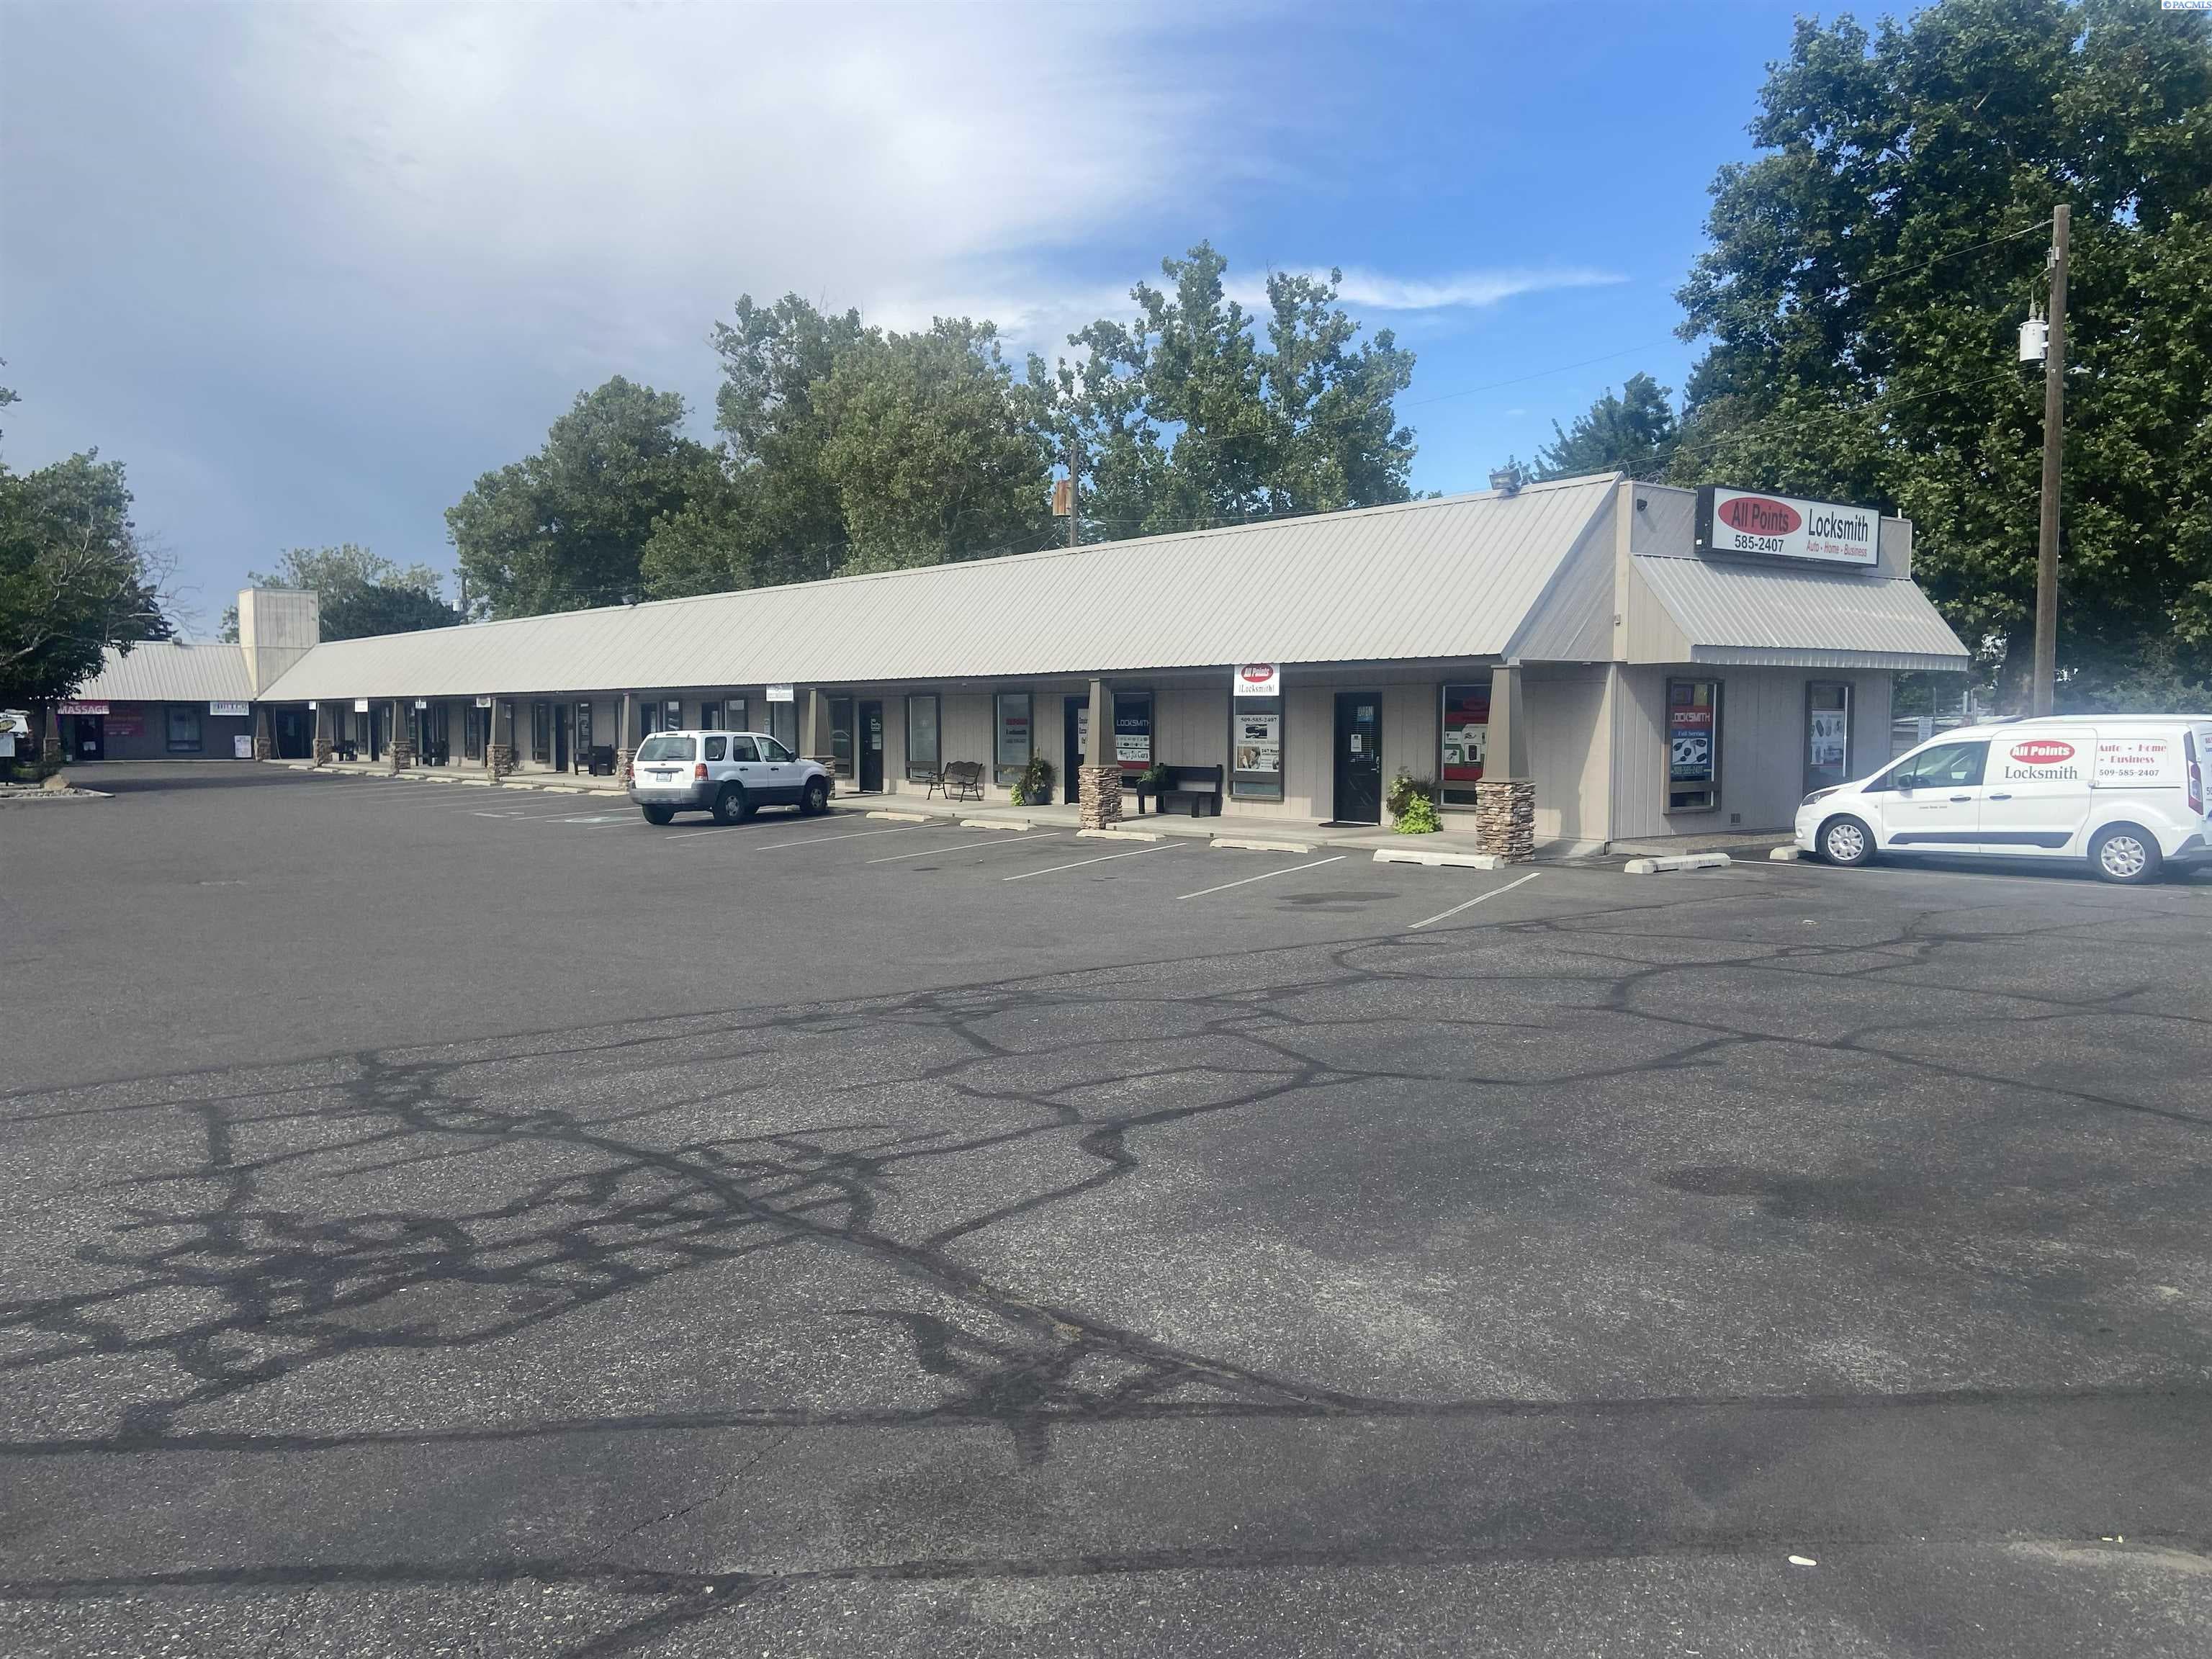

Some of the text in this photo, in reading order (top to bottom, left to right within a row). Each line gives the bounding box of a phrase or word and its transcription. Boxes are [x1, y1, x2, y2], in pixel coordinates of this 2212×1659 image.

[1731, 502, 1789, 532] All Points
[1808, 508, 1869, 541] Locksmith
[1735, 534, 1784, 552] 585-2407
[1806, 540, 1819, 552] Auto
[1824, 541, 1840, 554] Home
[1844, 544, 1867, 557] Business
[1241, 684, 1272, 693] Locksmith
[58, 705, 109, 714] MASSAGE
[2012, 745, 2071, 756] All Points
[2005, 765, 2078, 779] Locksmith
